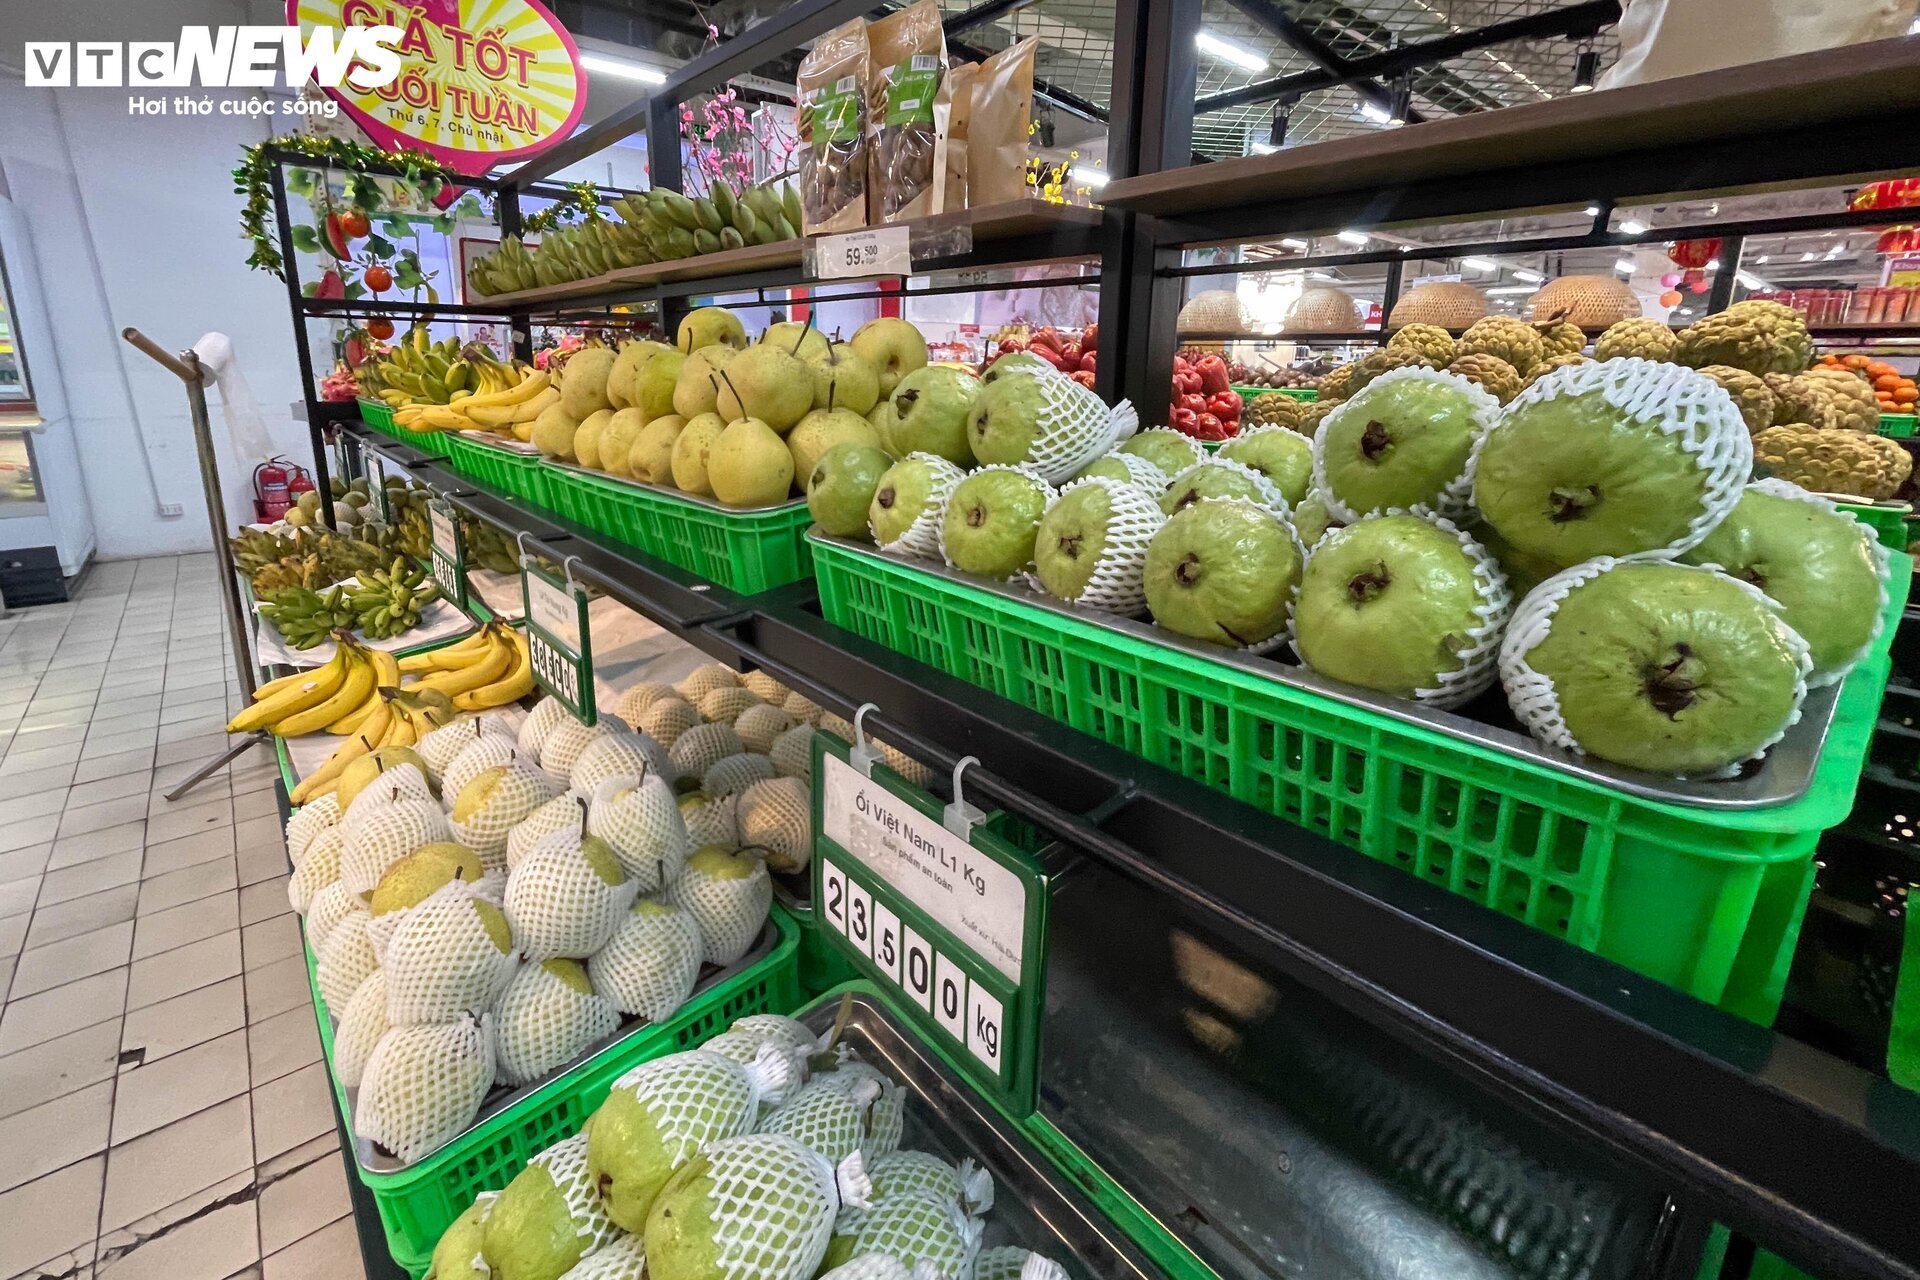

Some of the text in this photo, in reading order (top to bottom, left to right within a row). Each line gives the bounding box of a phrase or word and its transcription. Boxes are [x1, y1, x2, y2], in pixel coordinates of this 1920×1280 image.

[442, 25, 537, 88] TỐT
[387, 107, 504, 143] Thứ 6, 7, Chủ nhật
[446, 84, 539, 136] TUẦN
[856, 789, 985, 896] Ổi Việt Nam L1 Kg
[922, 865, 933, 878] an
[934, 872, 953, 893] toàn
[976, 1003, 998, 1058] kg
